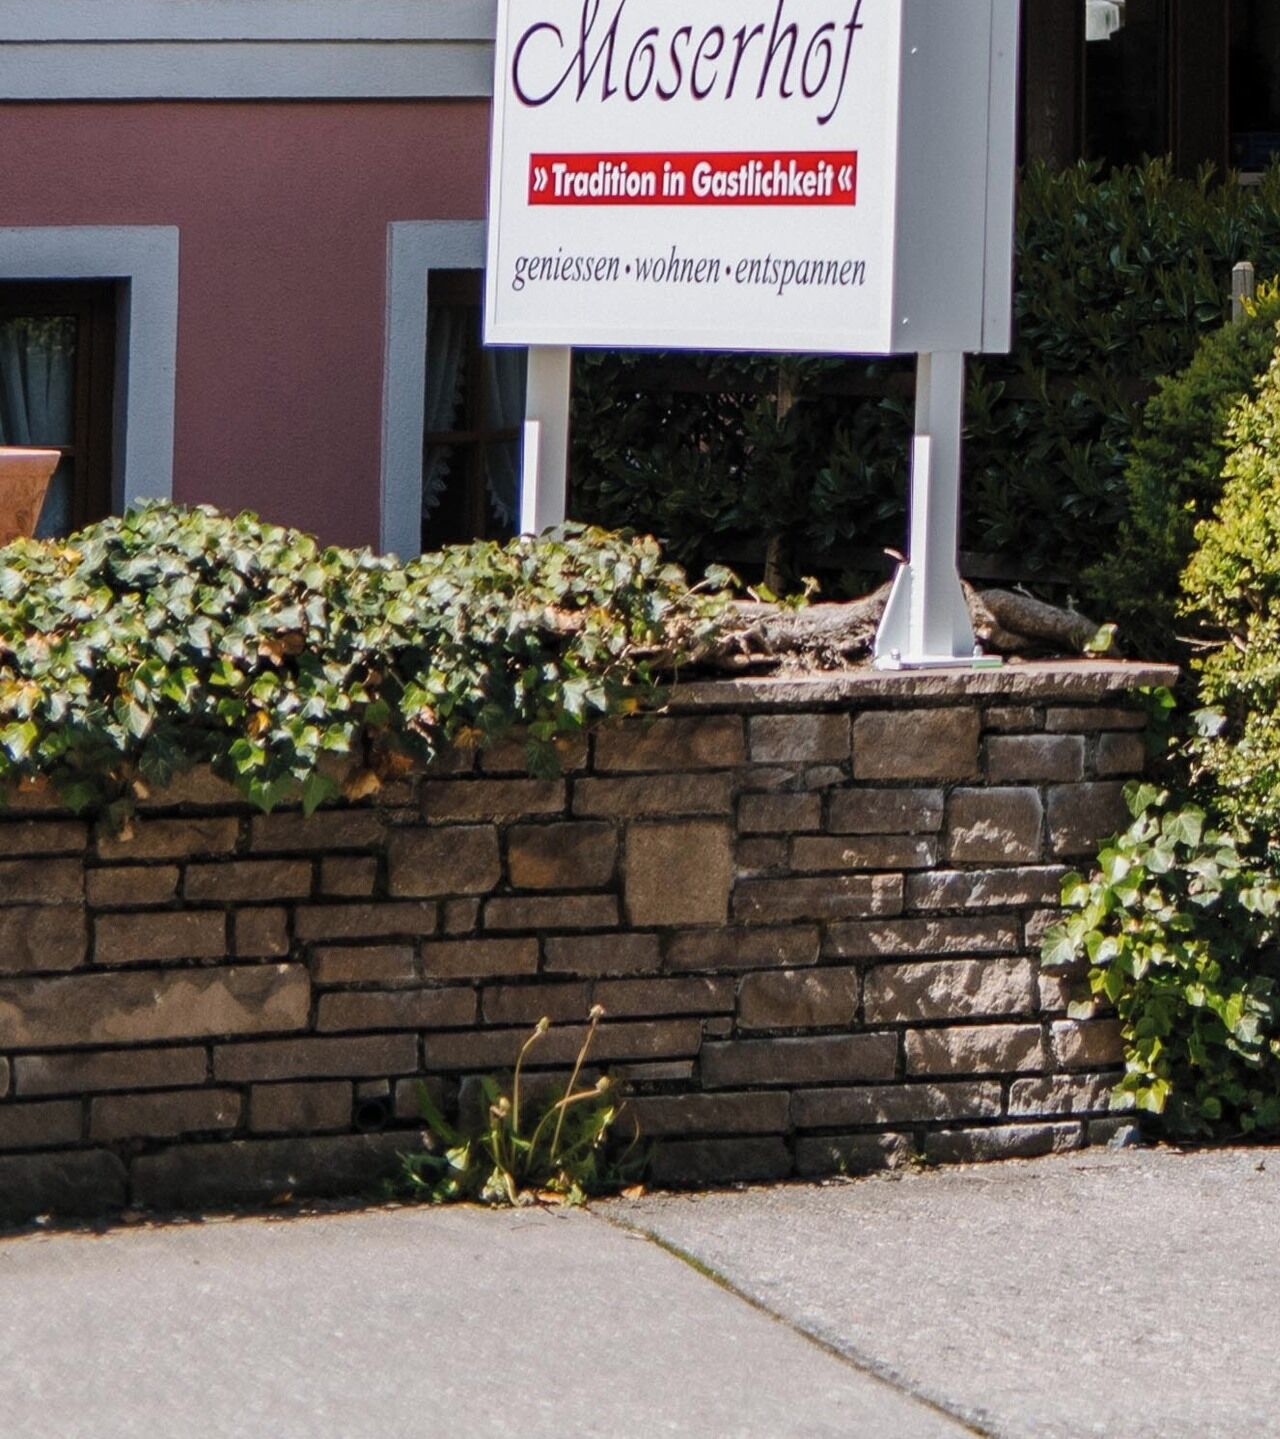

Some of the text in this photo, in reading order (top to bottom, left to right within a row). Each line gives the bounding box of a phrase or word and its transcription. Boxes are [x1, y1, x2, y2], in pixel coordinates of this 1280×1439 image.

[662, 161, 686, 197] in
[511, 245, 867, 296] geniessen wohnen entspannen
